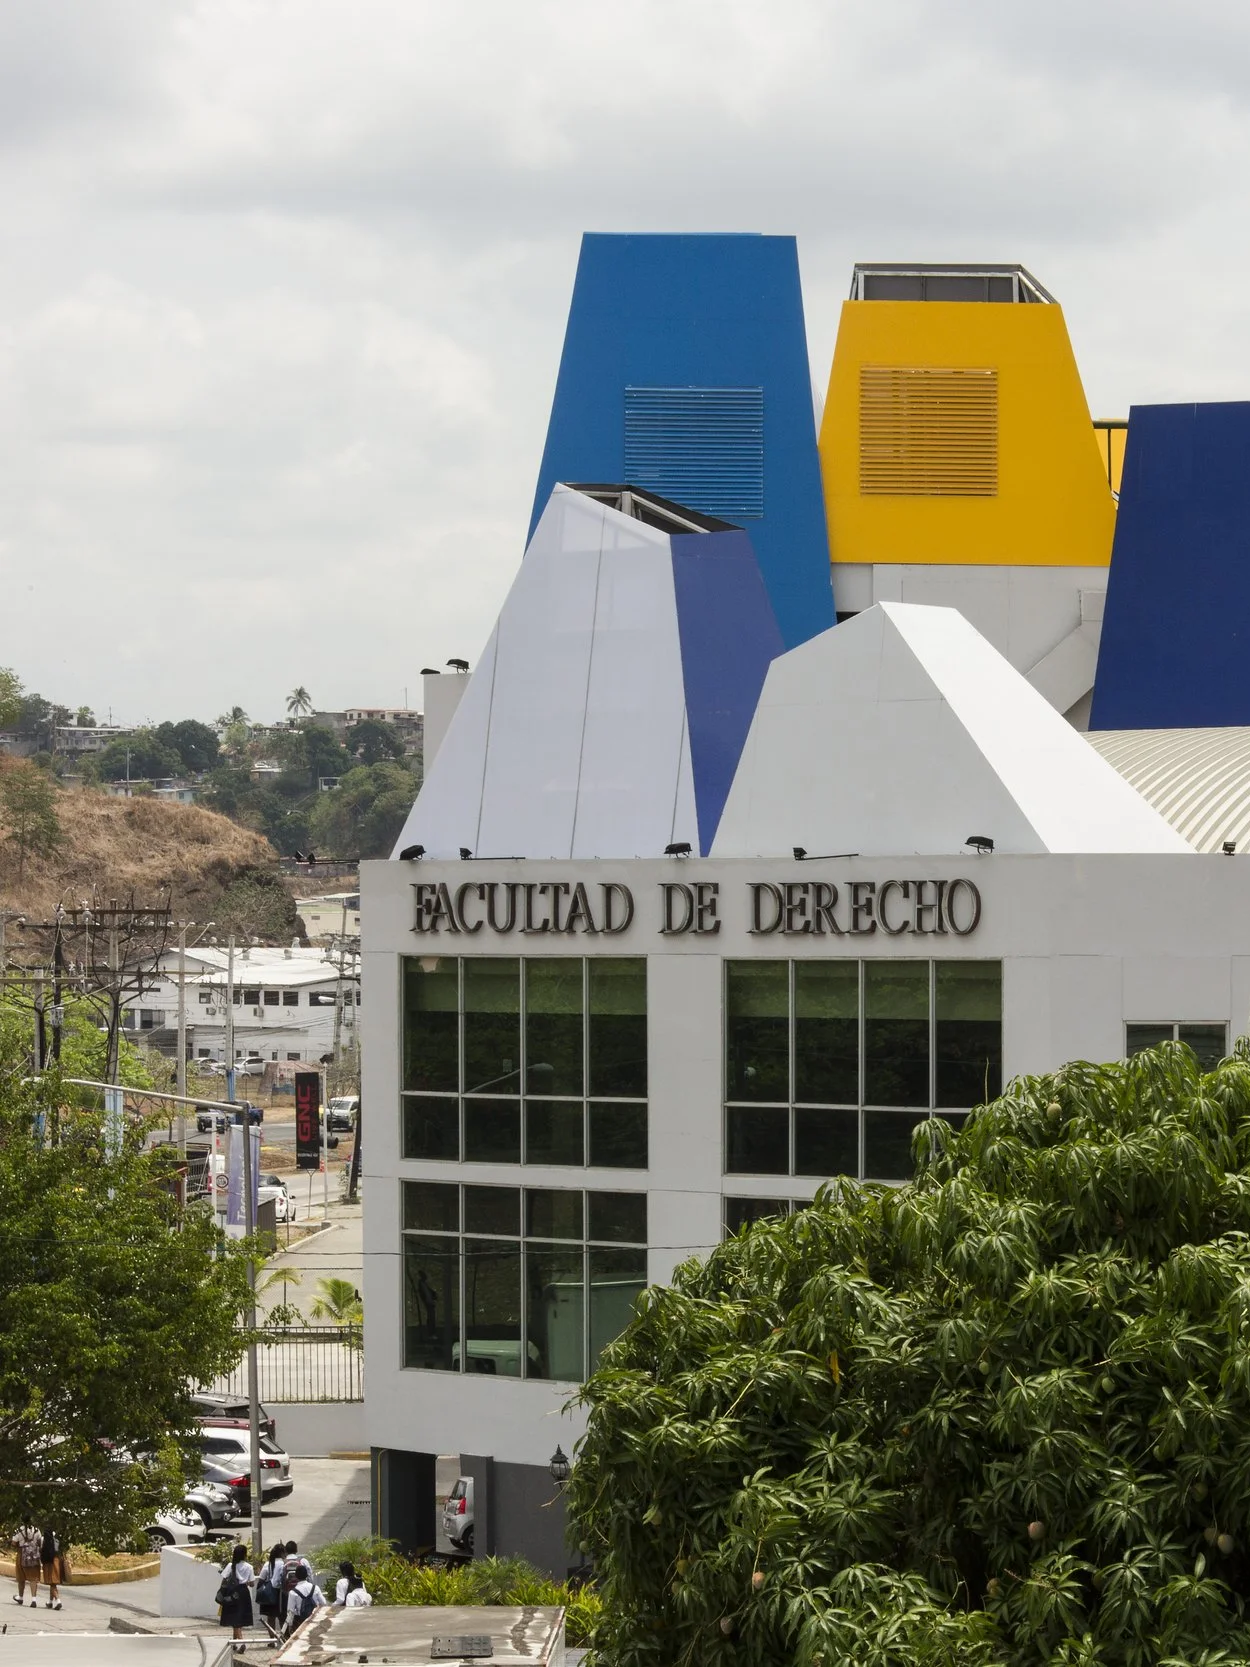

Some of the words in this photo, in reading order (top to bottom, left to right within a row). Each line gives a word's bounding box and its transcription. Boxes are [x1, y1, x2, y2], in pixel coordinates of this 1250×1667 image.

[409, 882, 635, 934] FACULTAD
[657, 882, 721, 934] DE
[746, 878, 982, 935] DERECHO
[298, 1085, 311, 1142] GNC
